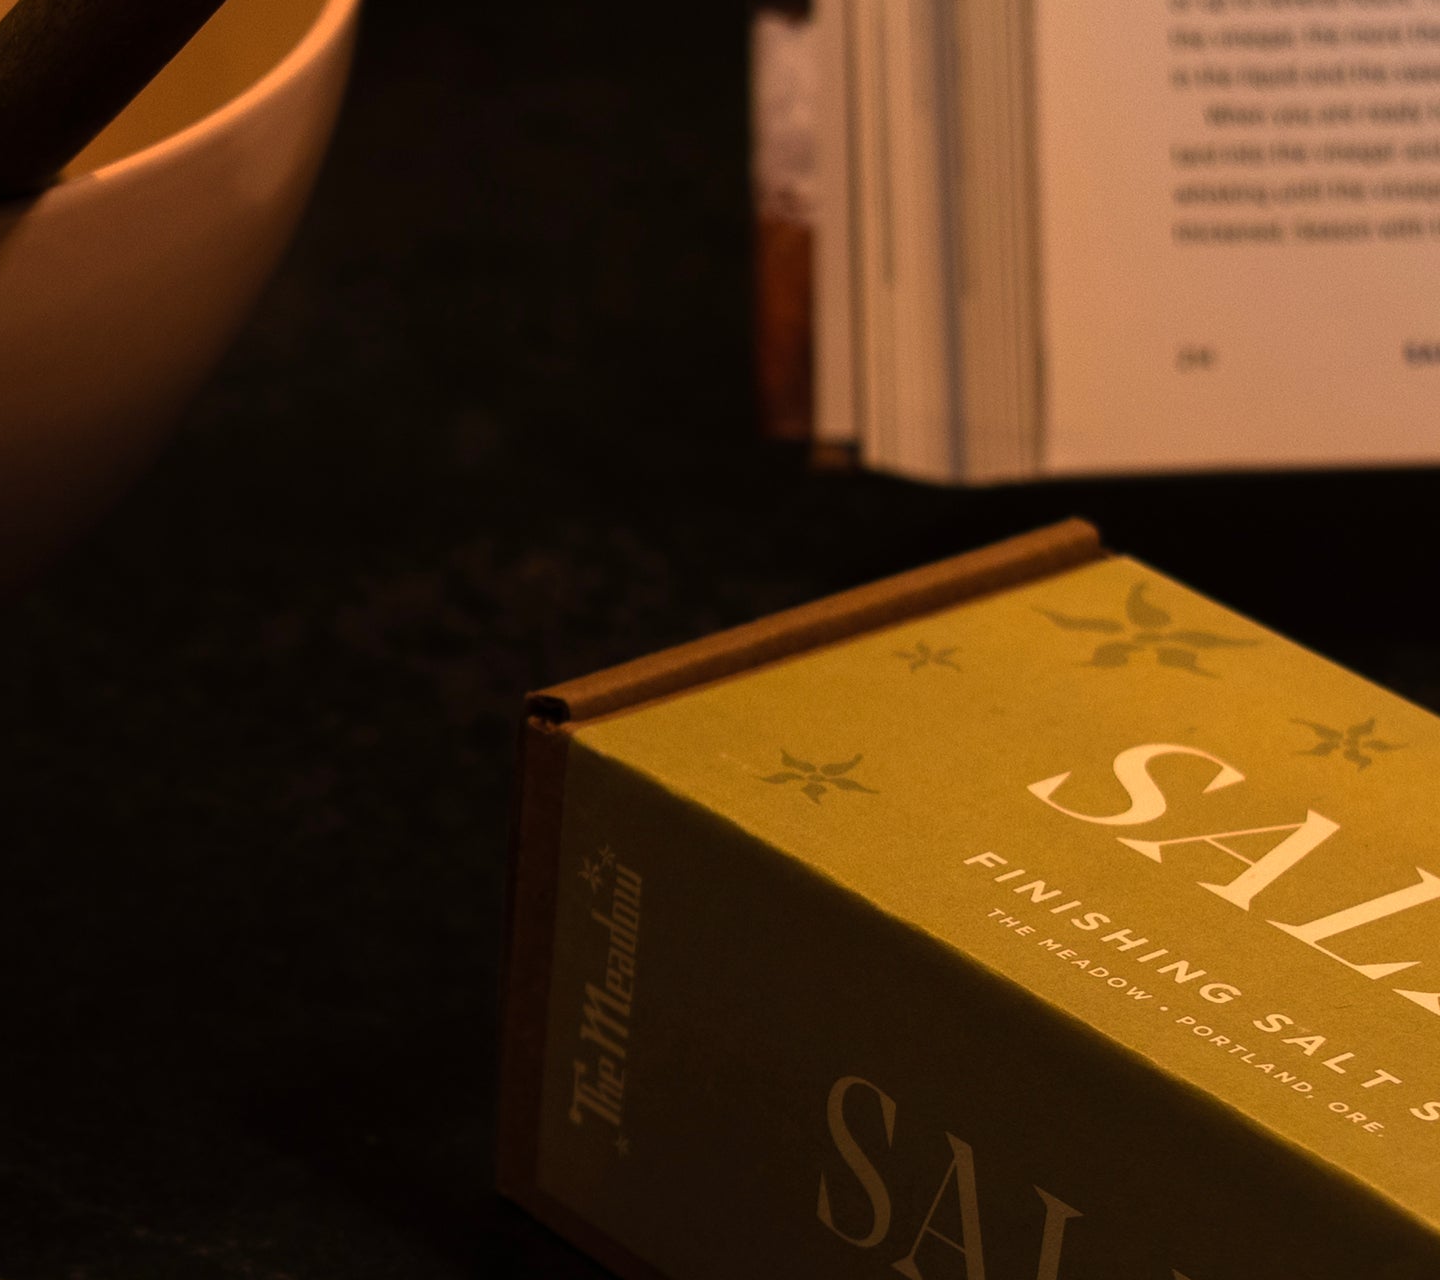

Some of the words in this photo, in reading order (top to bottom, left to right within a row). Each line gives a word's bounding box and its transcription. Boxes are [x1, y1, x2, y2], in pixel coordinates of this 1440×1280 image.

[964, 851, 1242, 1004] FINISHING
[1253, 1012, 1402, 1091] SALT
[987, 907, 1034, 937] THE
[1039, 938, 1153, 1003] MEADOW
[1328, 1101, 1385, 1138] ORE.
